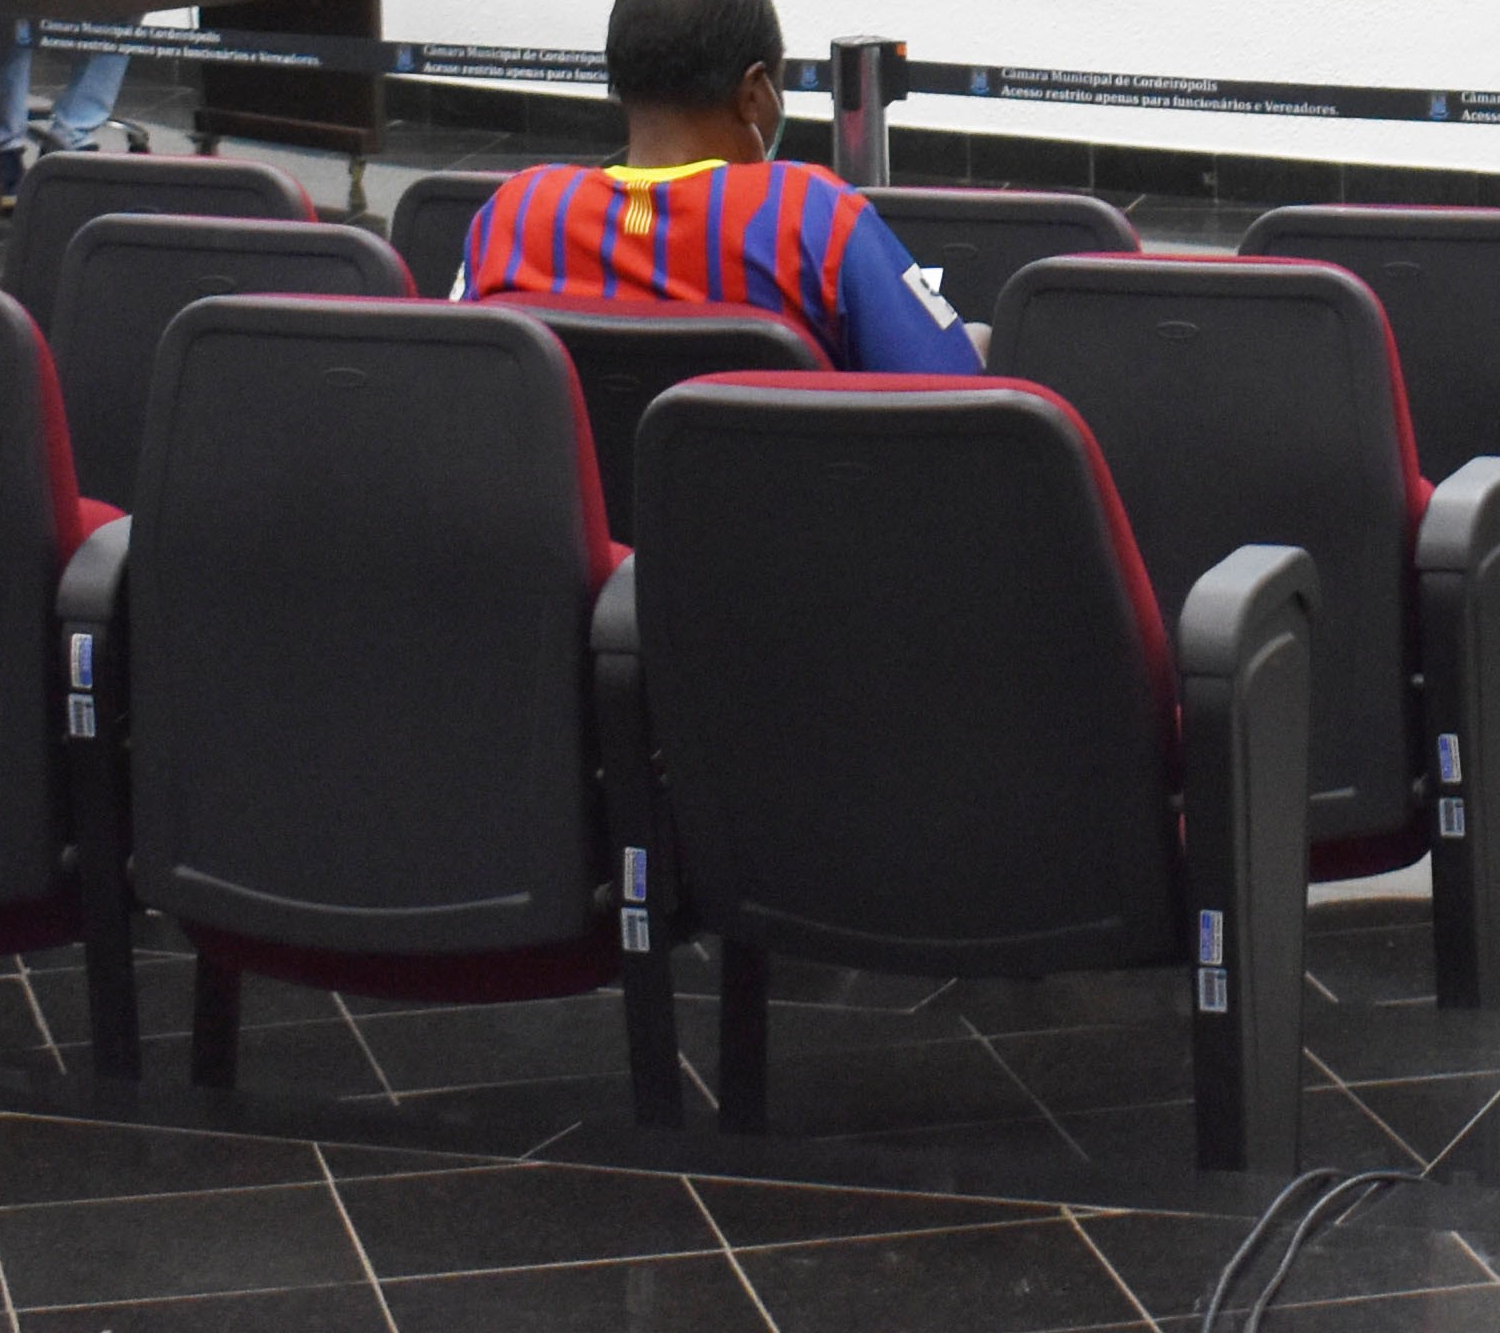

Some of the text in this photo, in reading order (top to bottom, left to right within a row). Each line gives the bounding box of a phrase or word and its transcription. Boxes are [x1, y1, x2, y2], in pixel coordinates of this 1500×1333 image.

[1002, 67, 1218, 93] Câmara Municipal de Cordeirópolis
[1002, 85, 1043, 98] Acesso
[1045, 88, 1092, 101] restrito
[1095, 92, 1139, 105] apenas
[1142, 95, 1170, 107] para
[1173, 96, 1251, 110] funcionários
[1254, 103, 1263, 111] e
